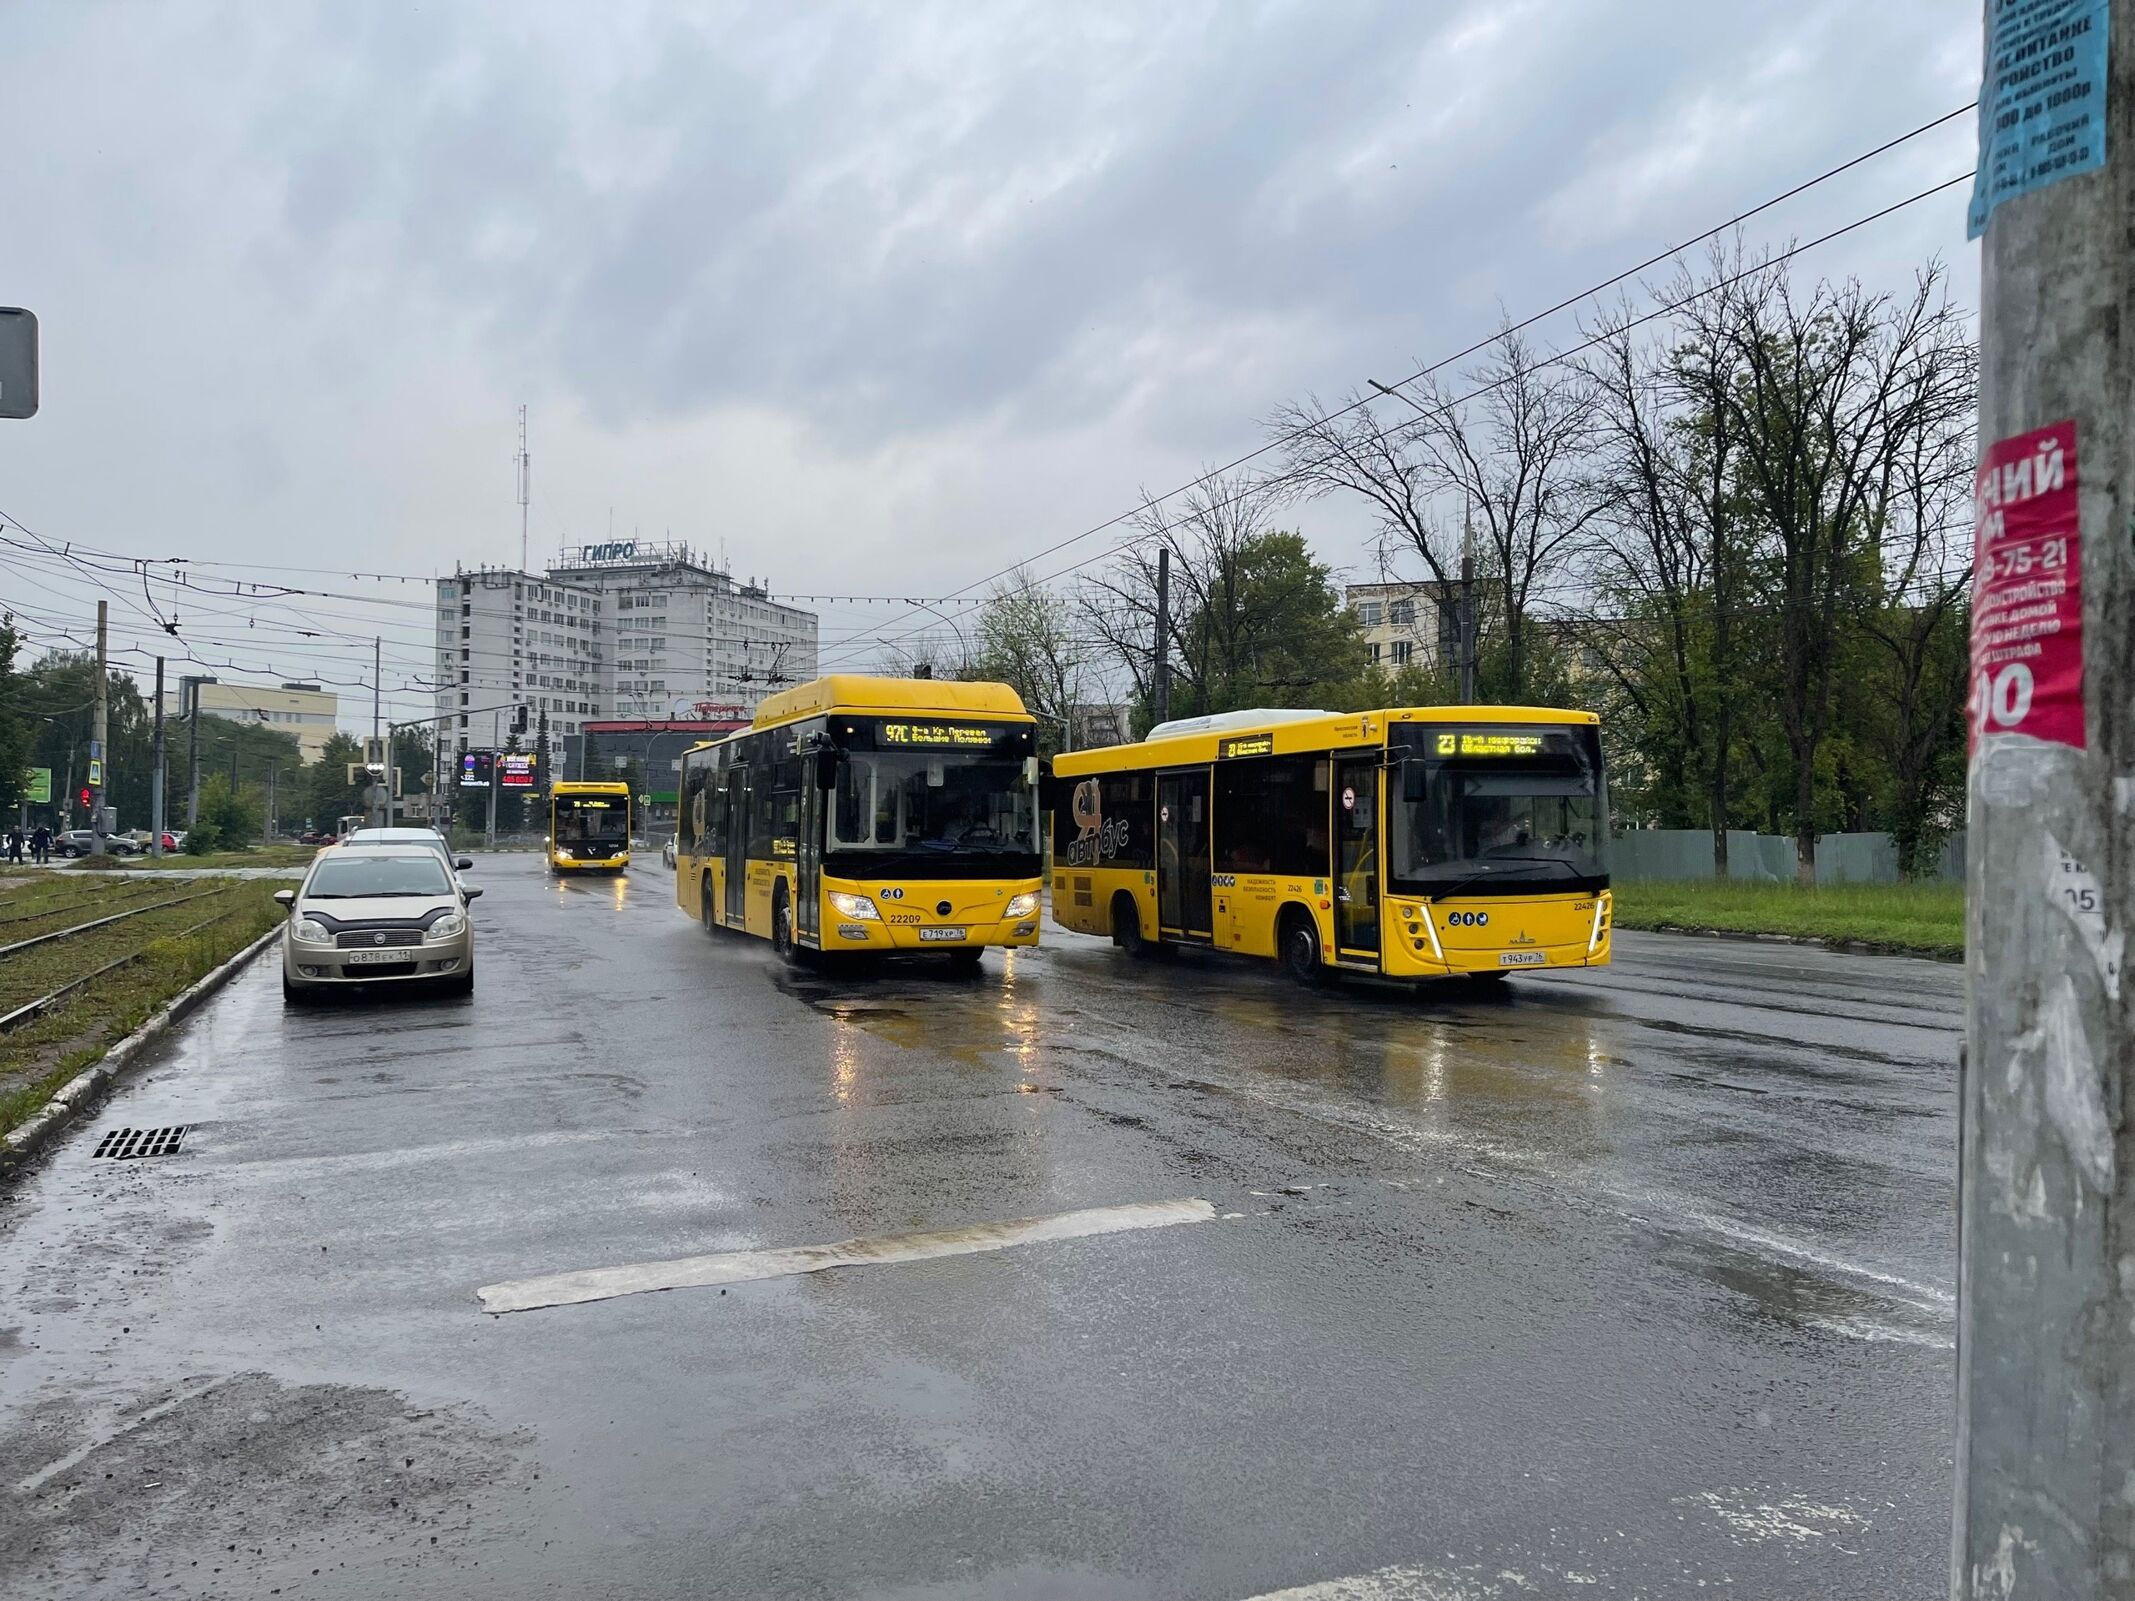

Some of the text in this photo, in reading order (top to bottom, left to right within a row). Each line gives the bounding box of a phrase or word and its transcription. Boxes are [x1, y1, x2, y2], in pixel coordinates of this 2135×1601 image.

[582, 543, 634, 561] ГИПРО
[1438, 734, 1456, 753] 23
[890, 914, 921, 924] 22209
